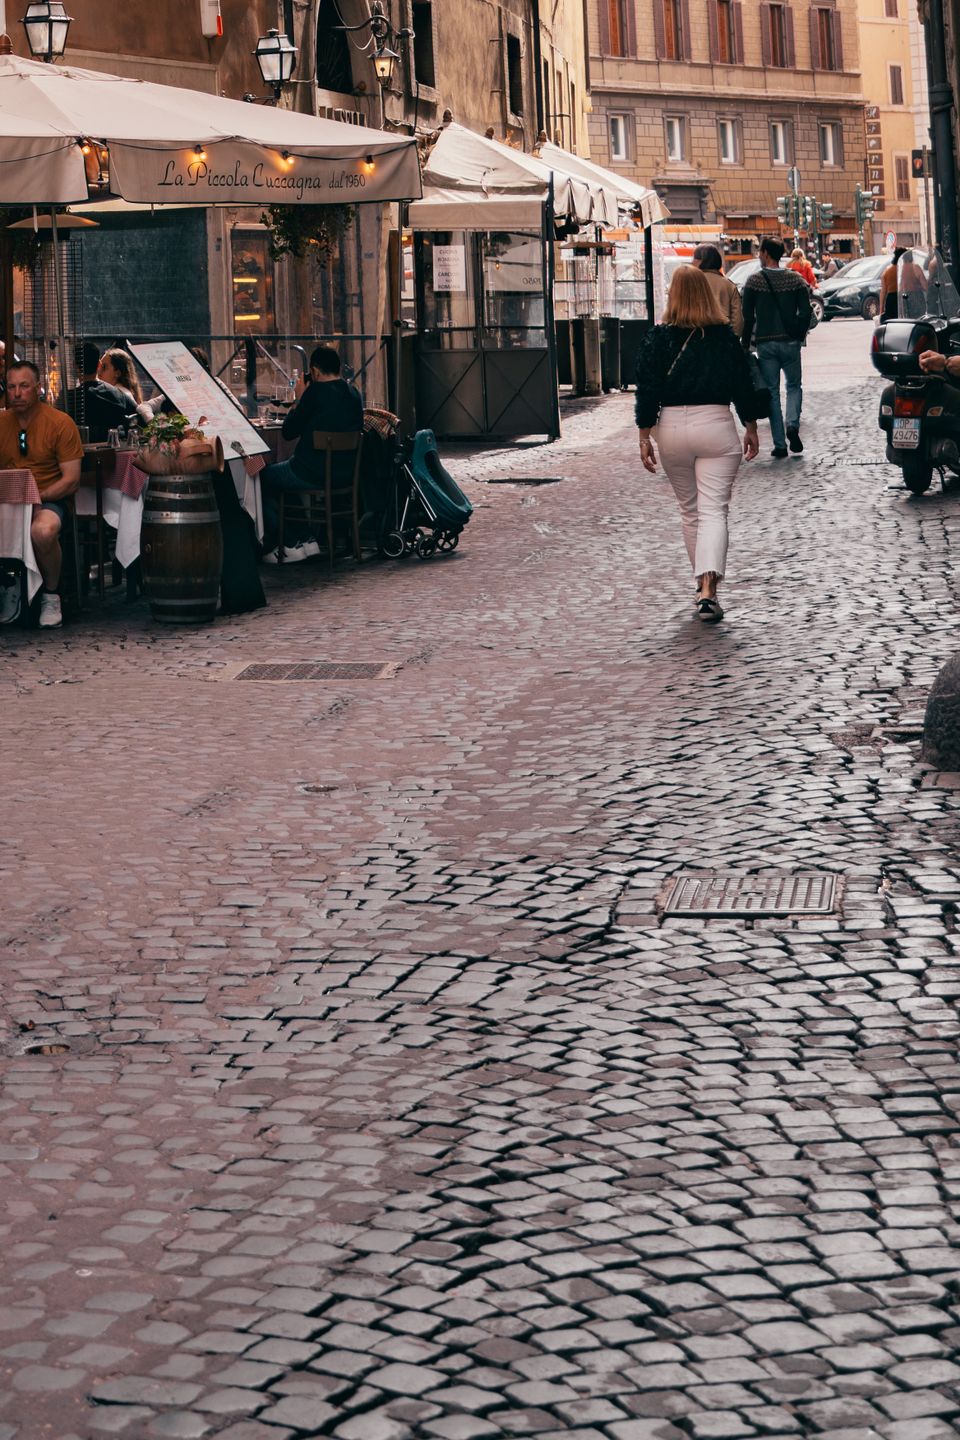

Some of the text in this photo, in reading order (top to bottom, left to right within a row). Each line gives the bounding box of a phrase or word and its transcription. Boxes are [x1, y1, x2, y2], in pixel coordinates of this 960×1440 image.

[157, 160, 184, 187] La
[187, 160, 249, 187] Piccola
[252, 162, 321, 201] Cuccagna
[346, 174, 366, 188] 1950
[893, 430, 918, 441] 49476
